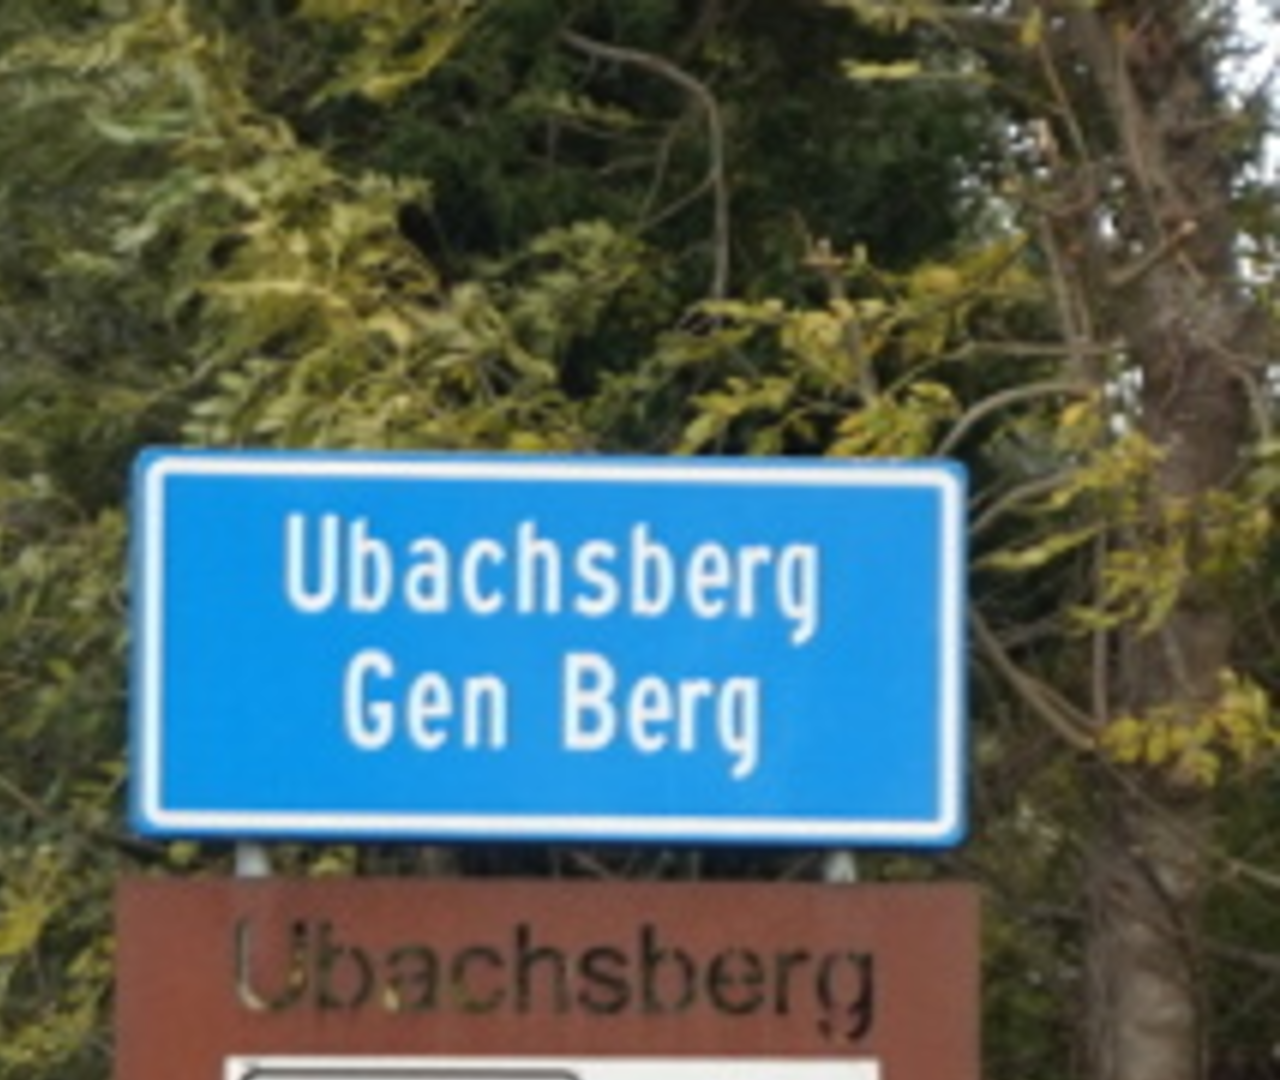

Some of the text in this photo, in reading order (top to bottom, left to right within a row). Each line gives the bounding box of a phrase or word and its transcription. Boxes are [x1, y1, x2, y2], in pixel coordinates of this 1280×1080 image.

[285, 513, 820, 646] Ubachsberg
[343, 648, 761, 780] Gen Berg
[236, 918, 875, 1043] Ubachsberg
